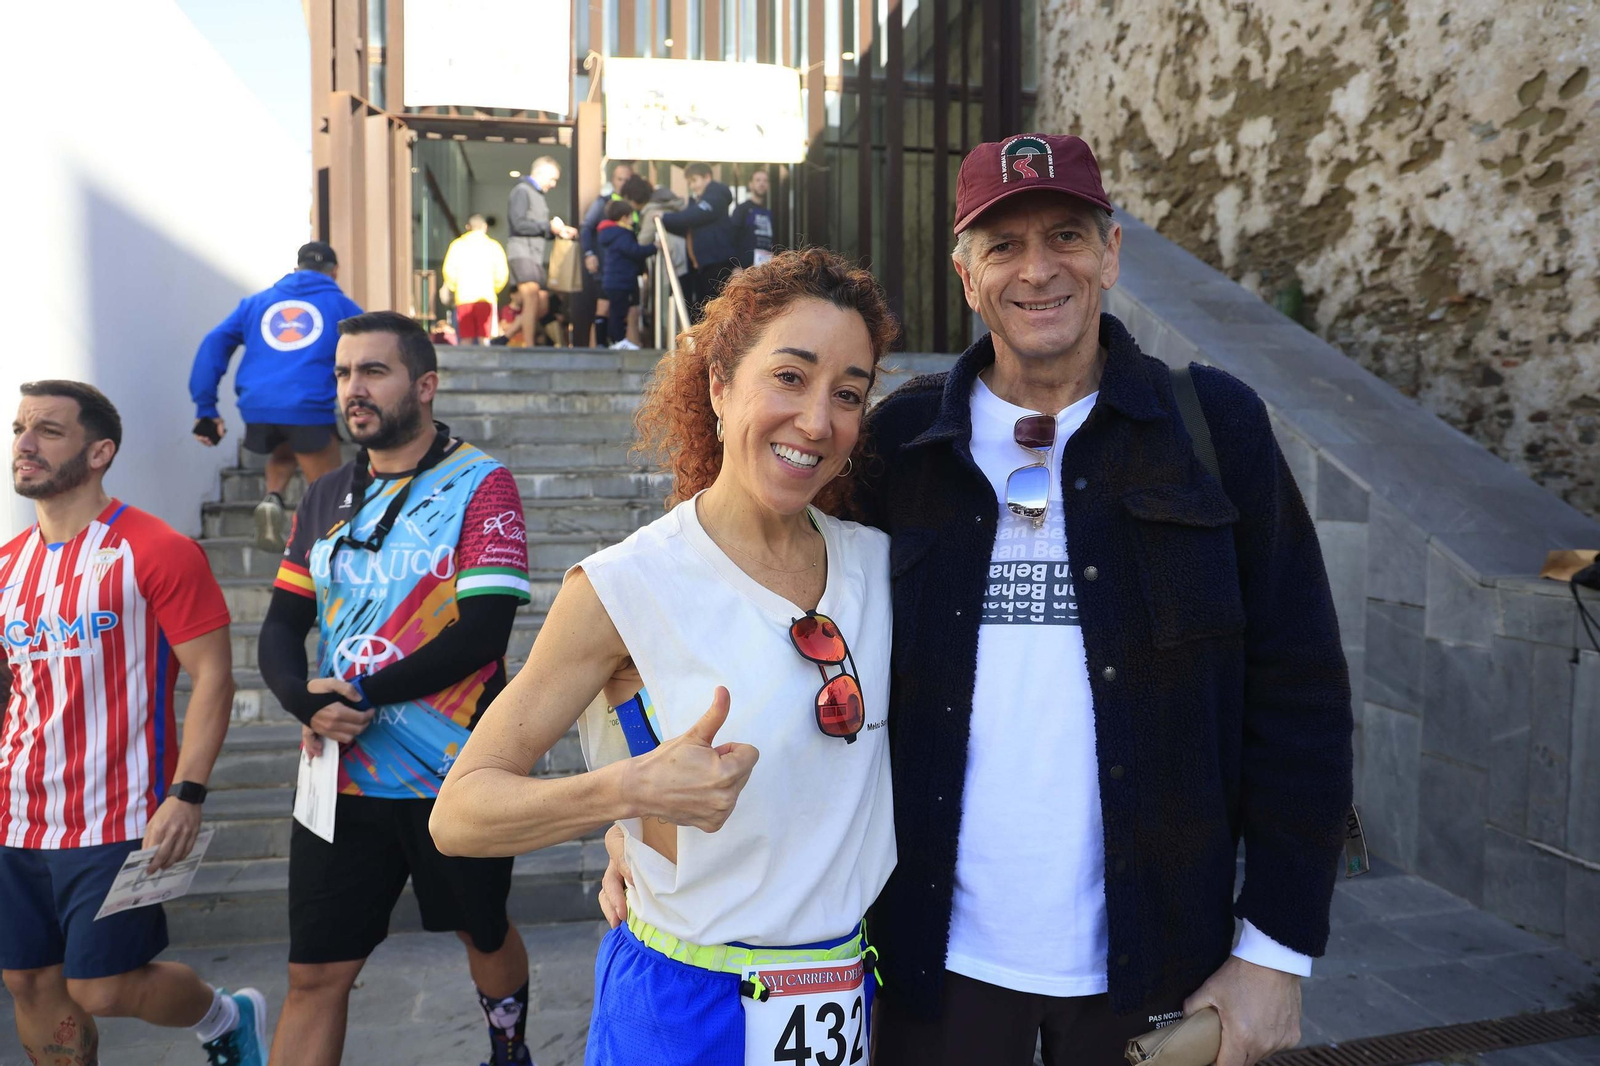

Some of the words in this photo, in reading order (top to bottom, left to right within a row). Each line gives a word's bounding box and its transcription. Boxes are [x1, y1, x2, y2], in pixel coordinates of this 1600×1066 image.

[987, 563, 1047, 581] Beha
[350, 587, 387, 598] TEAM
[984, 583, 1047, 600] Beha
[372, 705, 409, 725] AX
[763, 975, 783, 989] XVI
[786, 972, 842, 986] CARRERA
[1148, 1014, 1163, 1023] PAS
[774, 995, 863, 1066] 432
